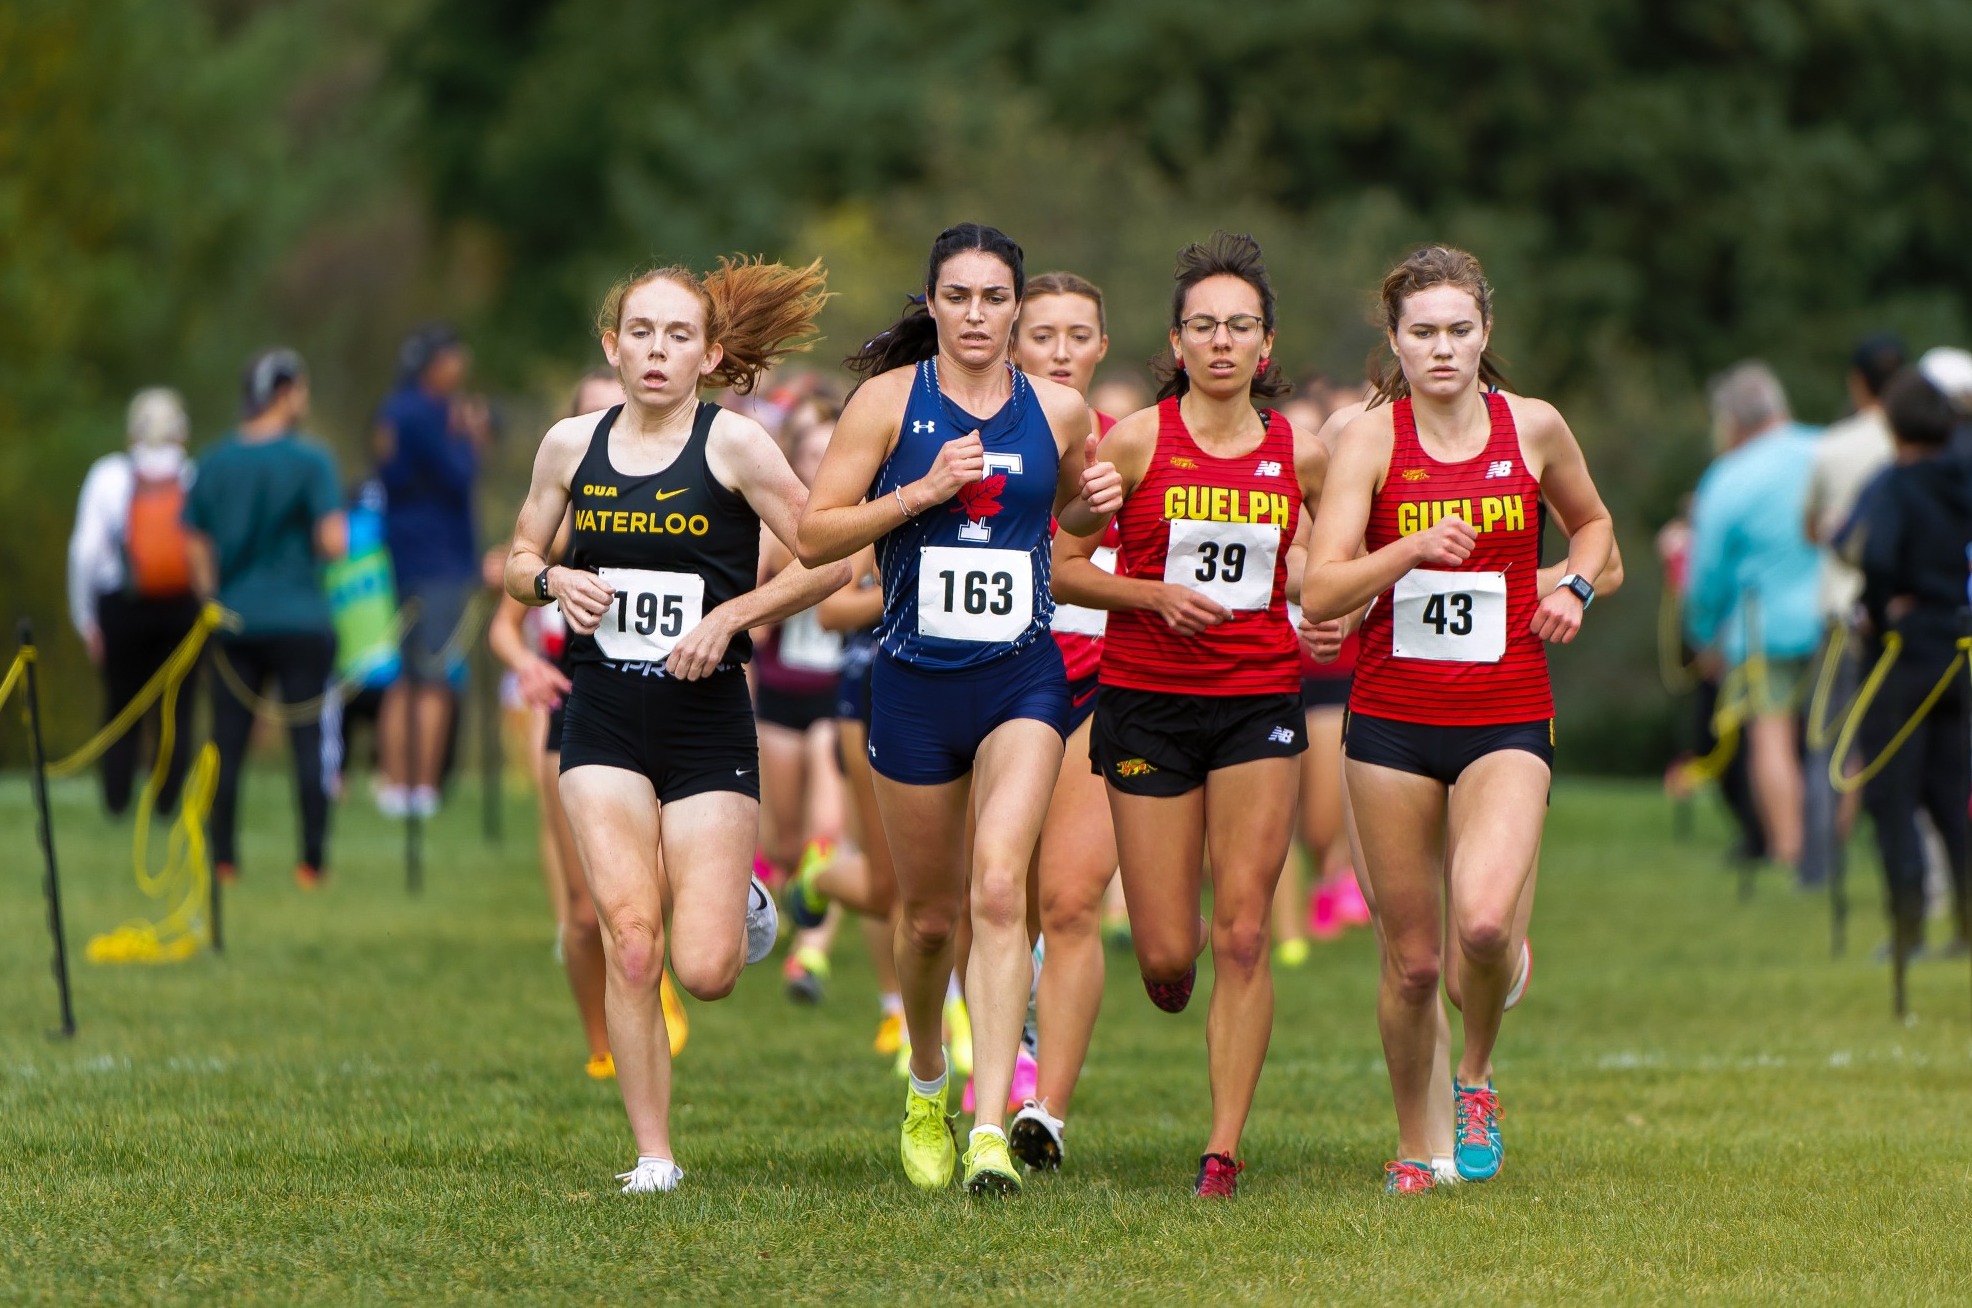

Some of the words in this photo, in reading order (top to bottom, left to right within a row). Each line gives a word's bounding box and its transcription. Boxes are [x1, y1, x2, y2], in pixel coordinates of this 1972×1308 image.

[583, 484, 618, 497] OUA
[1164, 485, 1289, 530] GUELPH
[575, 509, 709, 536] WATERLOO
[1195, 541, 1247, 583] 39
[614, 590, 684, 637] 195
[938, 569, 1013, 615] 163
[1422, 593, 1473, 636] 43
